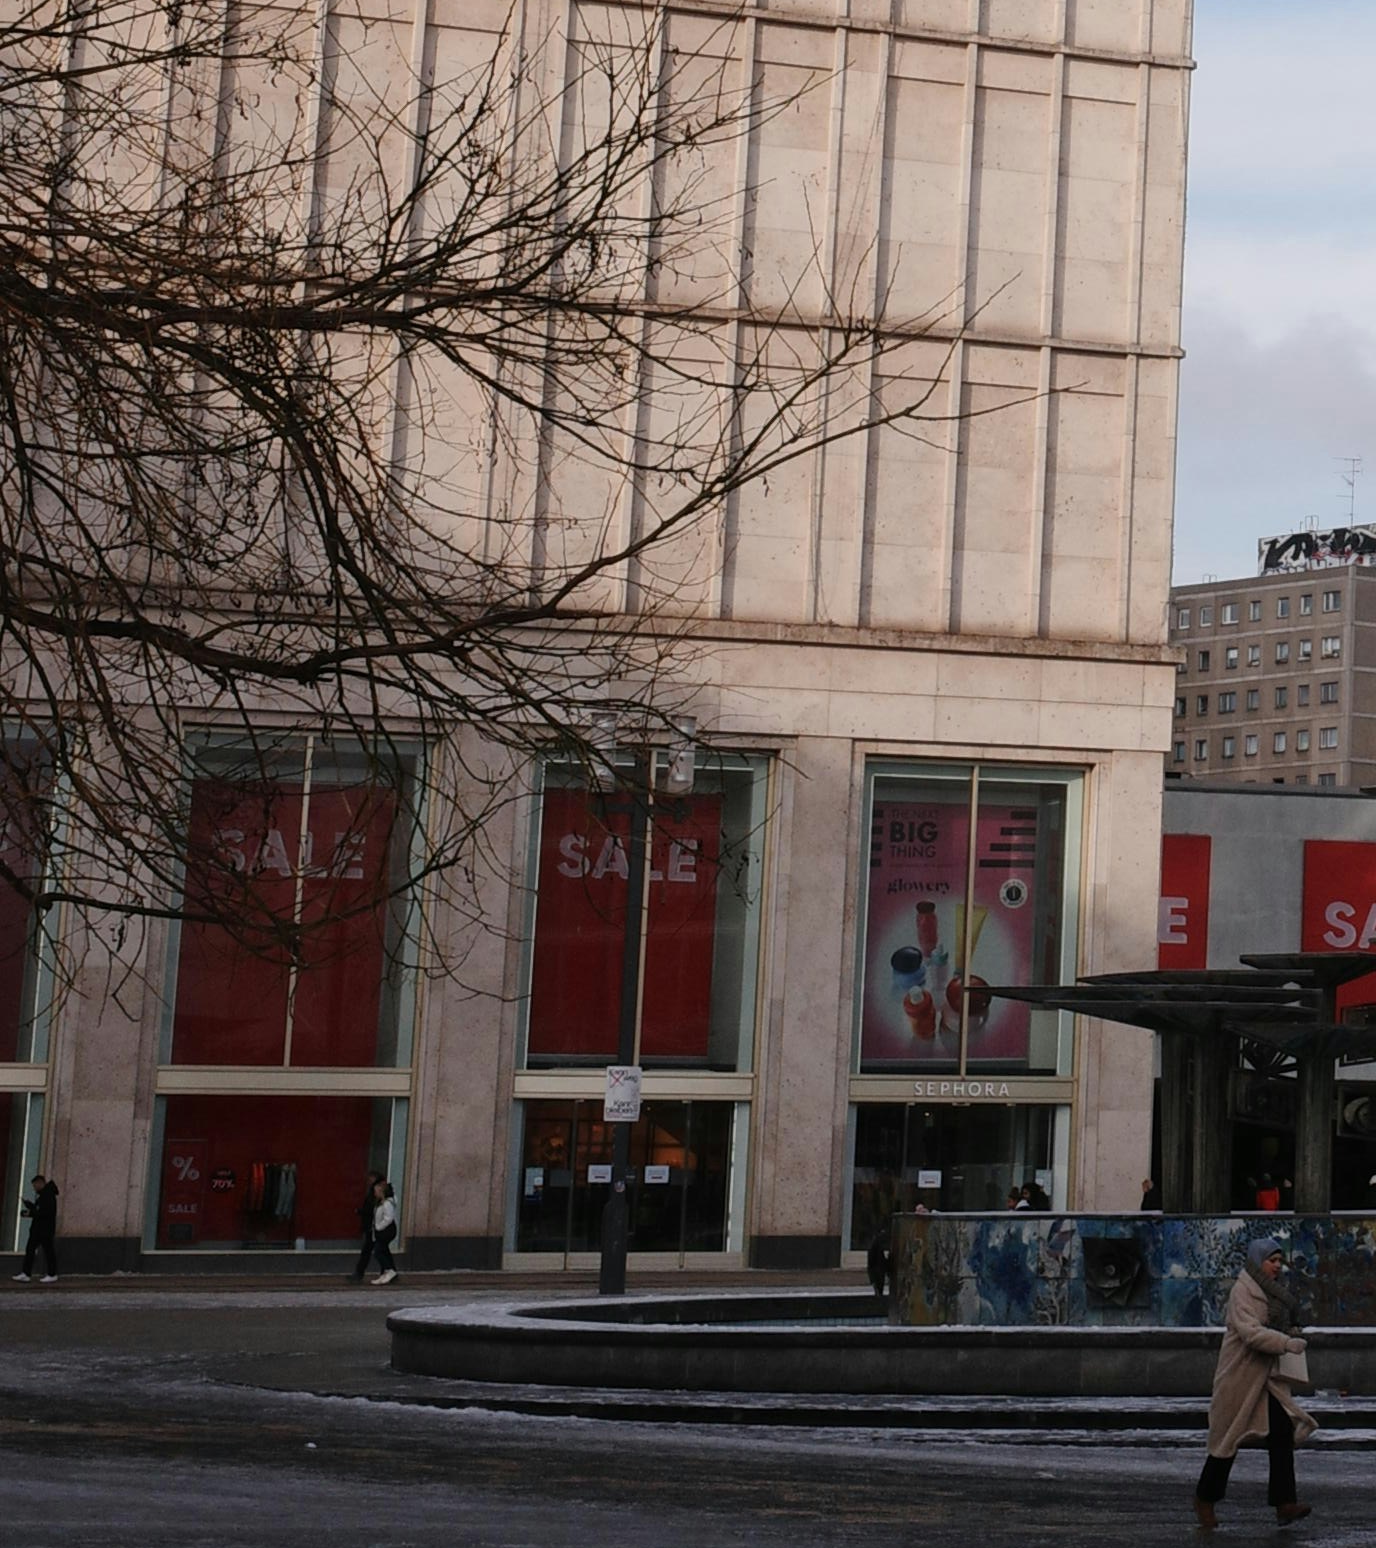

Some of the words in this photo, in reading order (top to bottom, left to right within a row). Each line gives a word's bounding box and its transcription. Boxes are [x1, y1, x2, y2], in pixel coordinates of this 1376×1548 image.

[890, 821, 938, 843] BIG
[557, 833, 699, 883] SAE
[890, 845, 937, 858] THING
[887, 879, 951, 895] glowery
[914, 1081, 1010, 1097] SEPHORA
[168, 1204, 198, 1214] SALE
